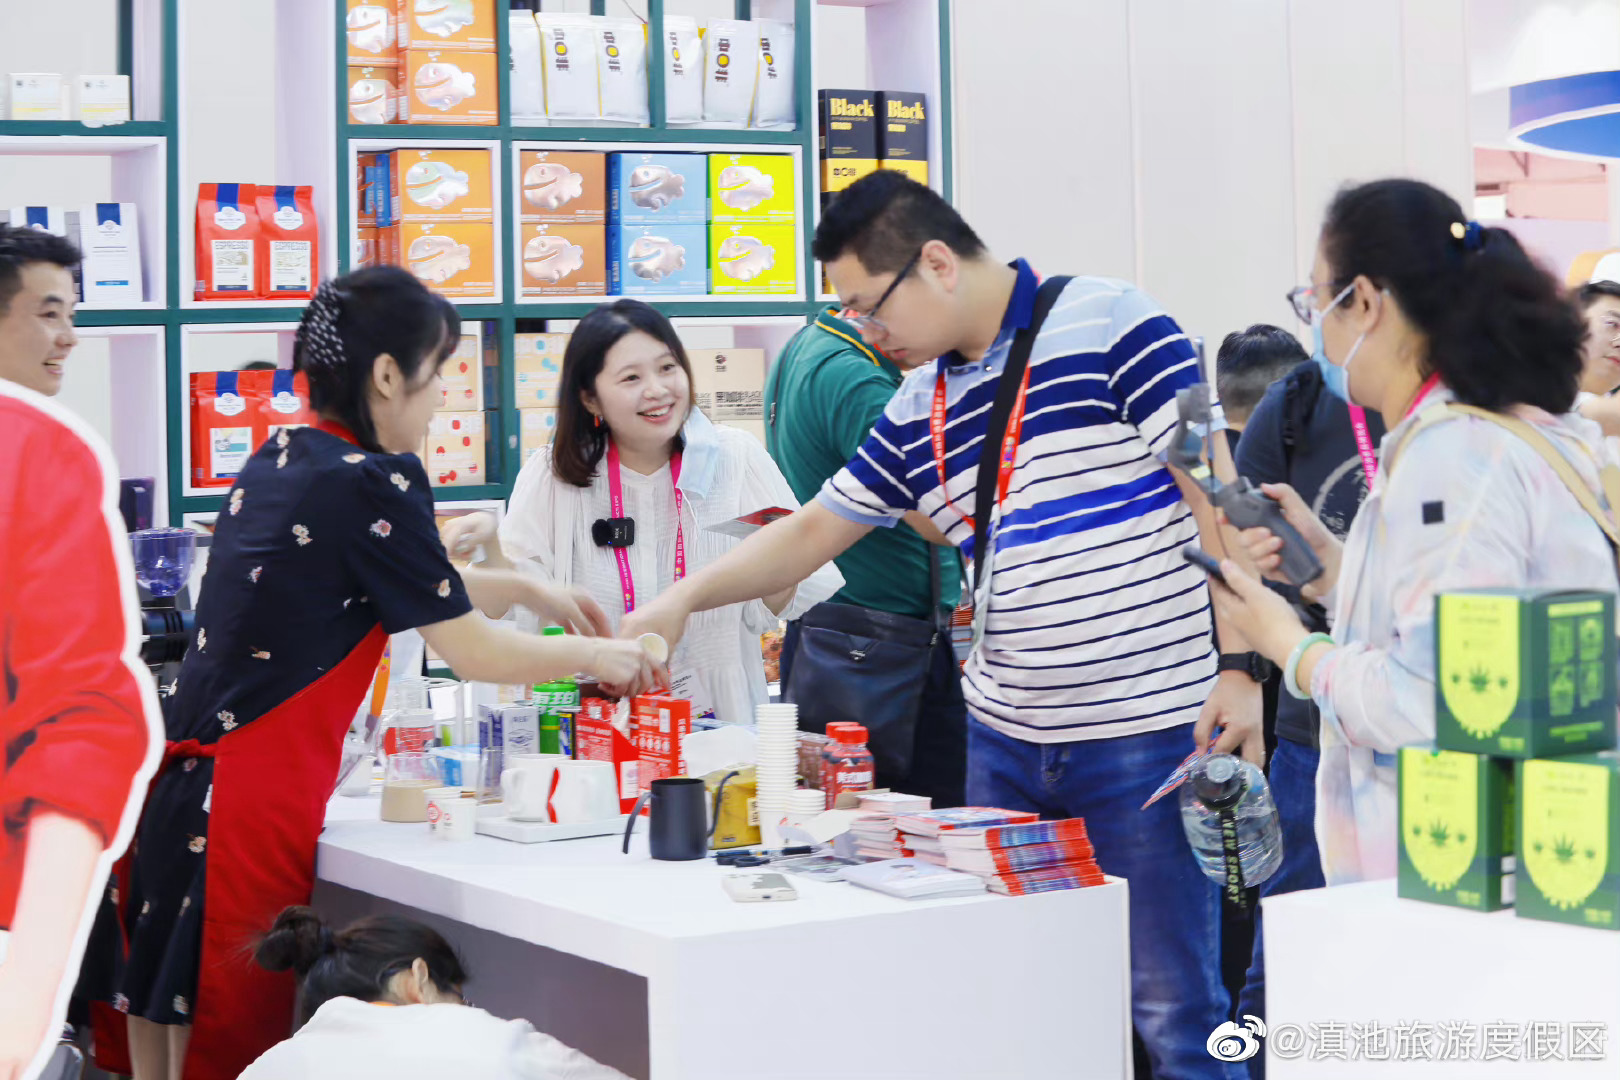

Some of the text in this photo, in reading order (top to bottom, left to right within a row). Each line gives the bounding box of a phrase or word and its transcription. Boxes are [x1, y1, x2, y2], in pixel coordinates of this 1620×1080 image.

[830, 98, 874, 117] Black
[887, 100, 925, 119] Black
[1226, 855, 1240, 904] SPORT
